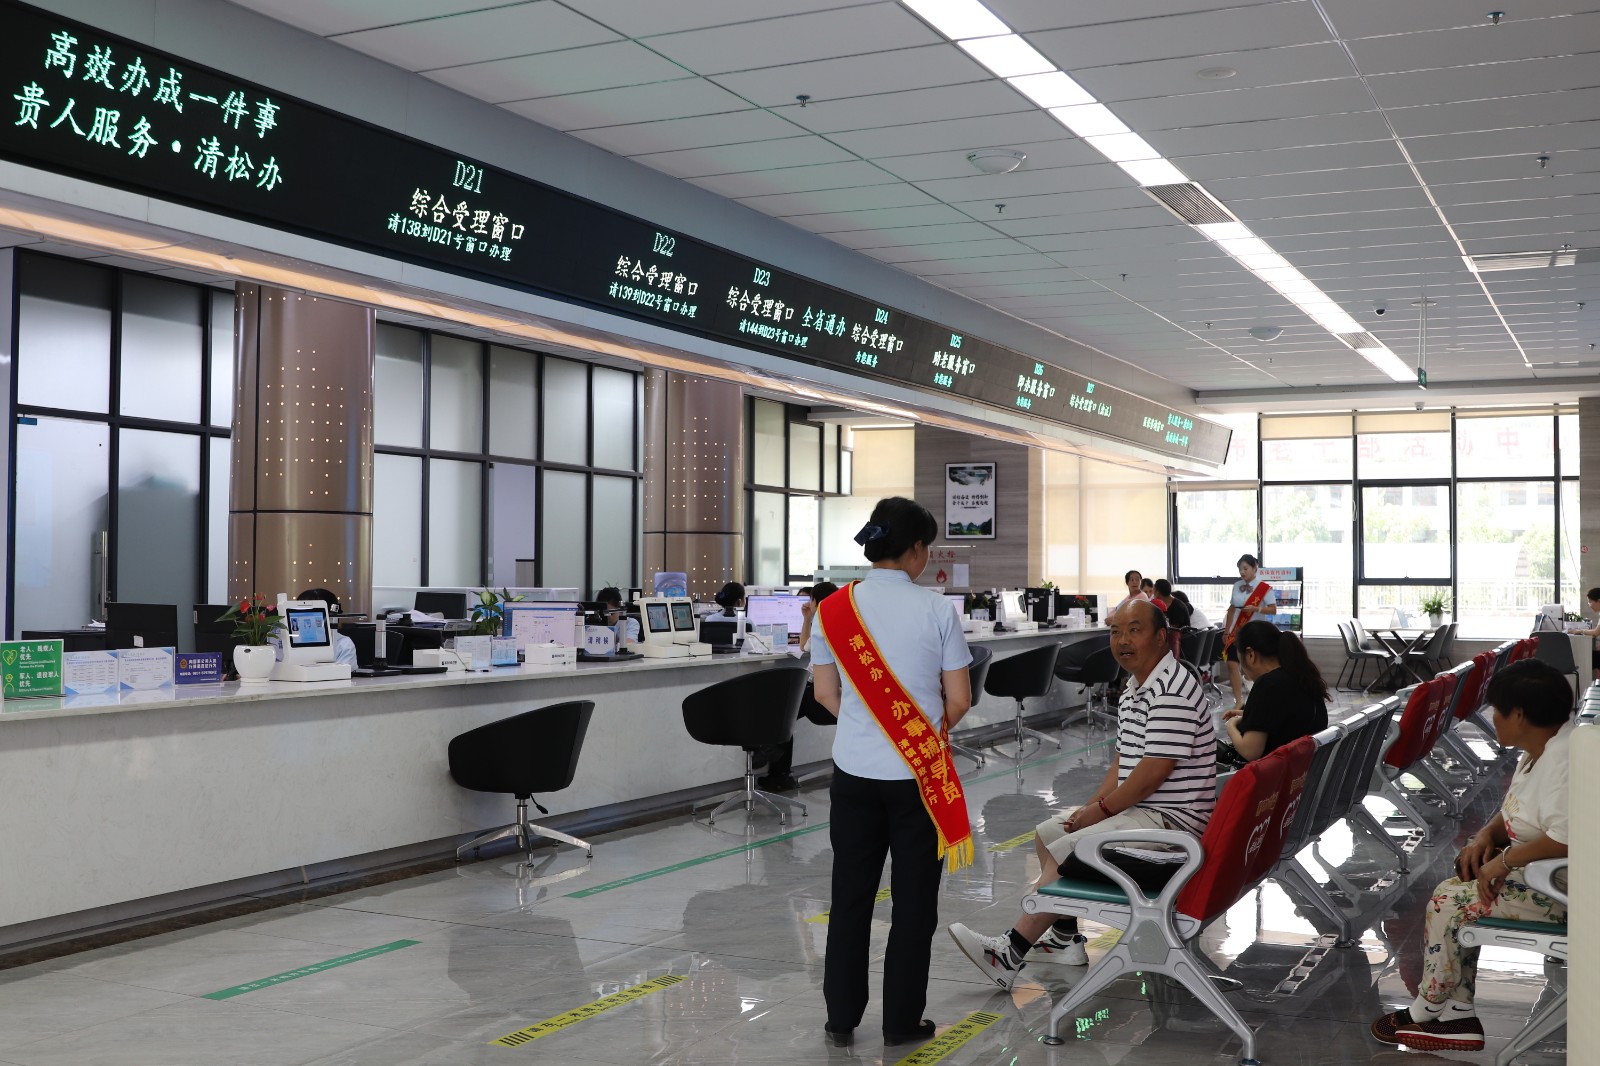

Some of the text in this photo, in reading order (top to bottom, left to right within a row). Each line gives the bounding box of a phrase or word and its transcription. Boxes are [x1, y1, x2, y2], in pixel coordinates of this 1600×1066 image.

[45, 31, 280, 138] 高效办成一件事
[13, 81, 283, 191] 贵人服务·清松办
[453, 161, 484, 194] D21
[409, 188, 525, 242] 综合受理窗口
[387, 212, 513, 262] 请138到D21号窗口办理
[653, 233, 675, 257] D22
[614, 255, 698, 296] 综合受理窗口
[753, 268, 771, 287] D23
[608, 281, 697, 318] 请139到D22号窗口办理
[726, 286, 794, 322] 综合受理窗口
[875, 308, 889, 324] D24
[801, 306, 846, 337] 全省通办
[851, 323, 904, 354] 综合受理窗口
[949, 334, 962, 348] D25
